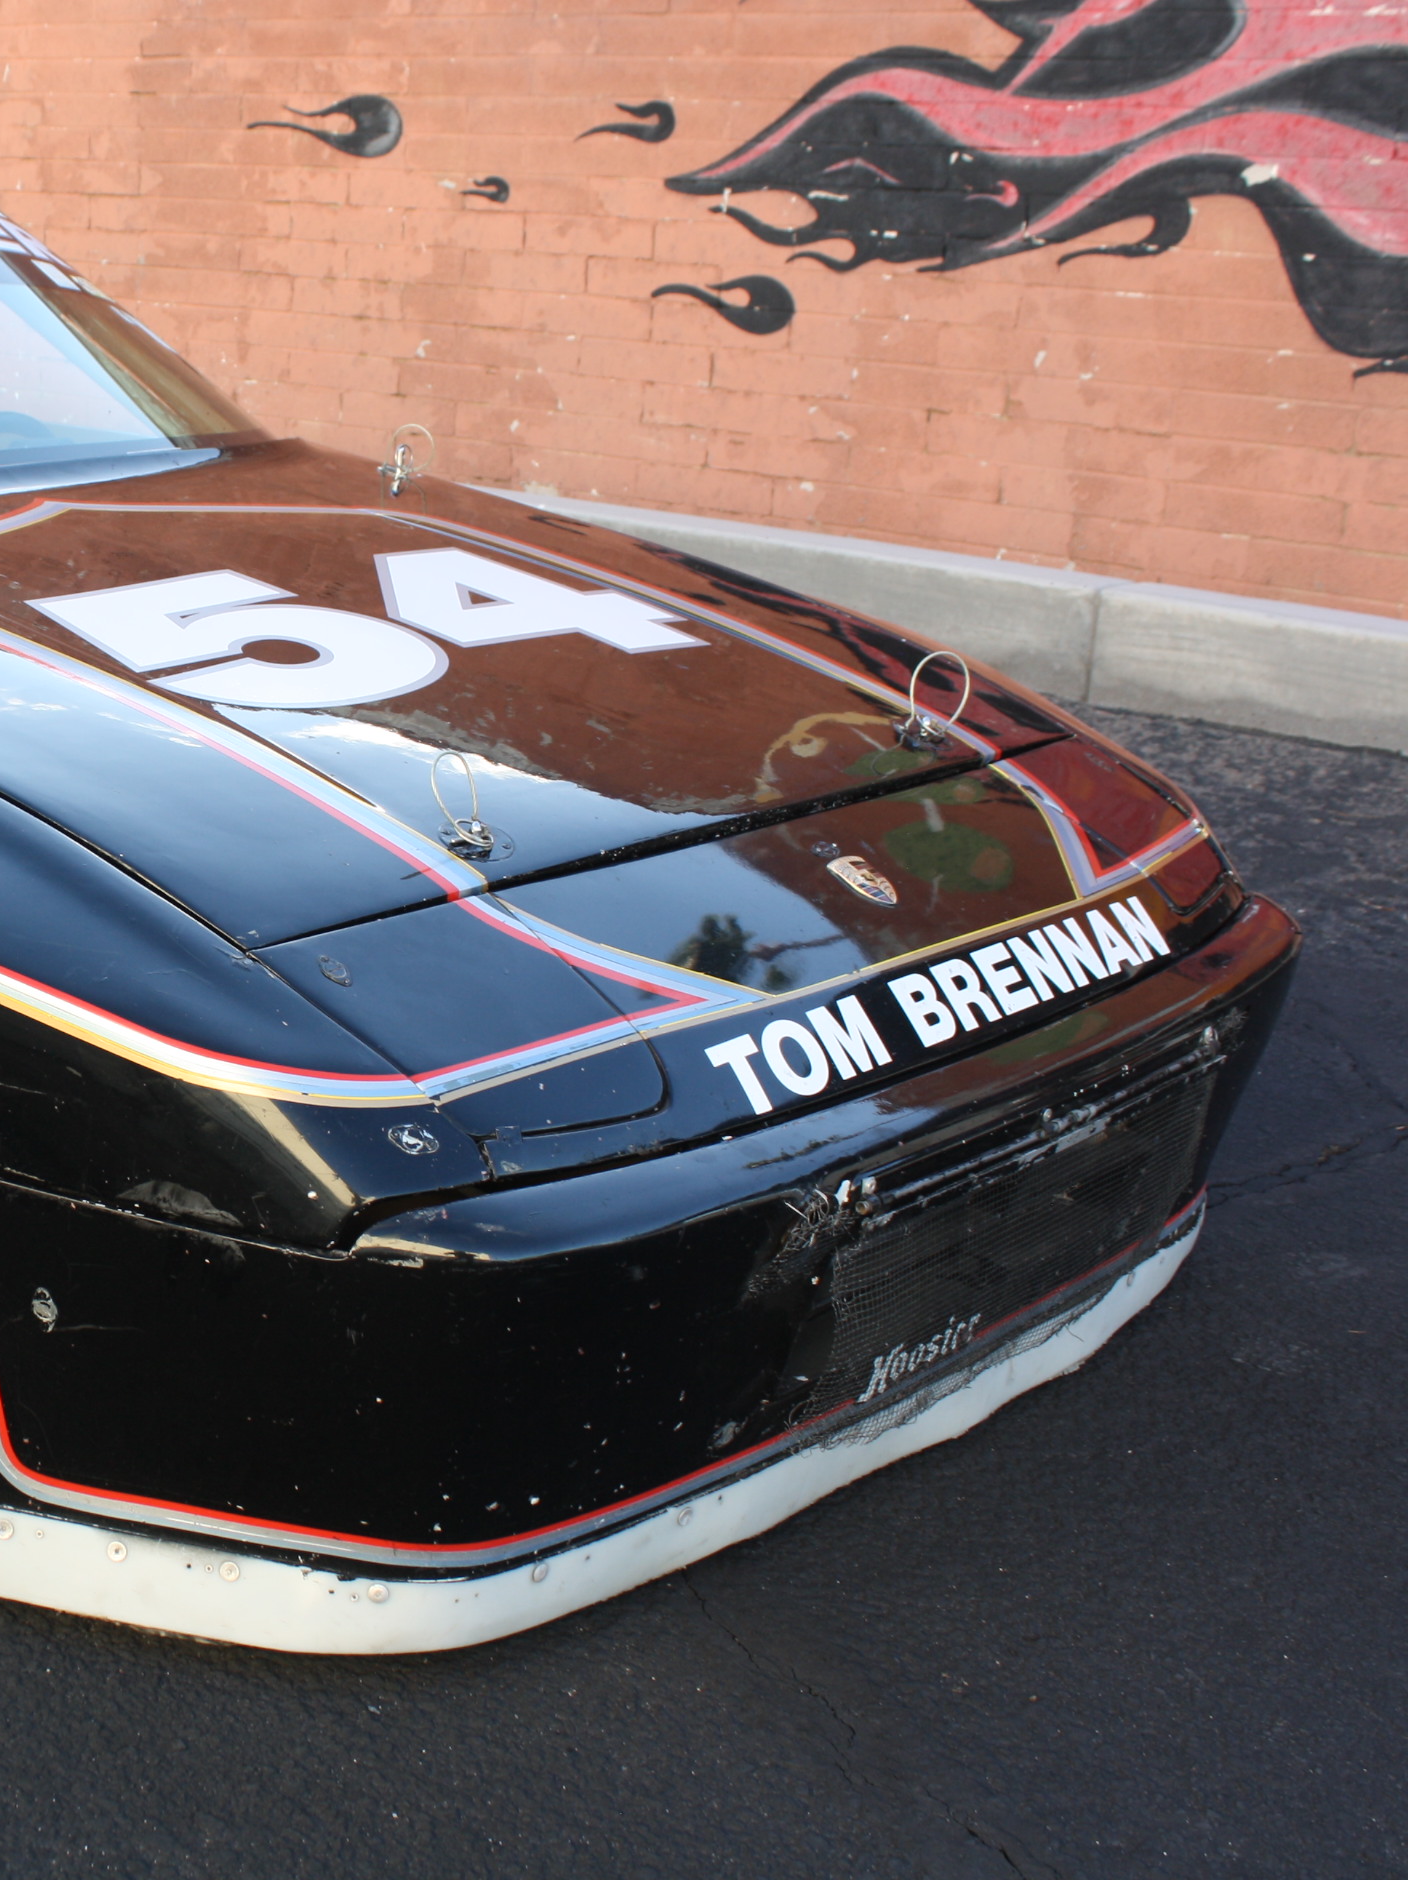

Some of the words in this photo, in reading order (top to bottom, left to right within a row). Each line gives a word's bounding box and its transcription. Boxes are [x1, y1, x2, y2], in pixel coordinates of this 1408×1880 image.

[24, 547, 711, 708] 54
[705, 996, 893, 1115] TOM
[887, 896, 1172, 1048] BRENNAN
